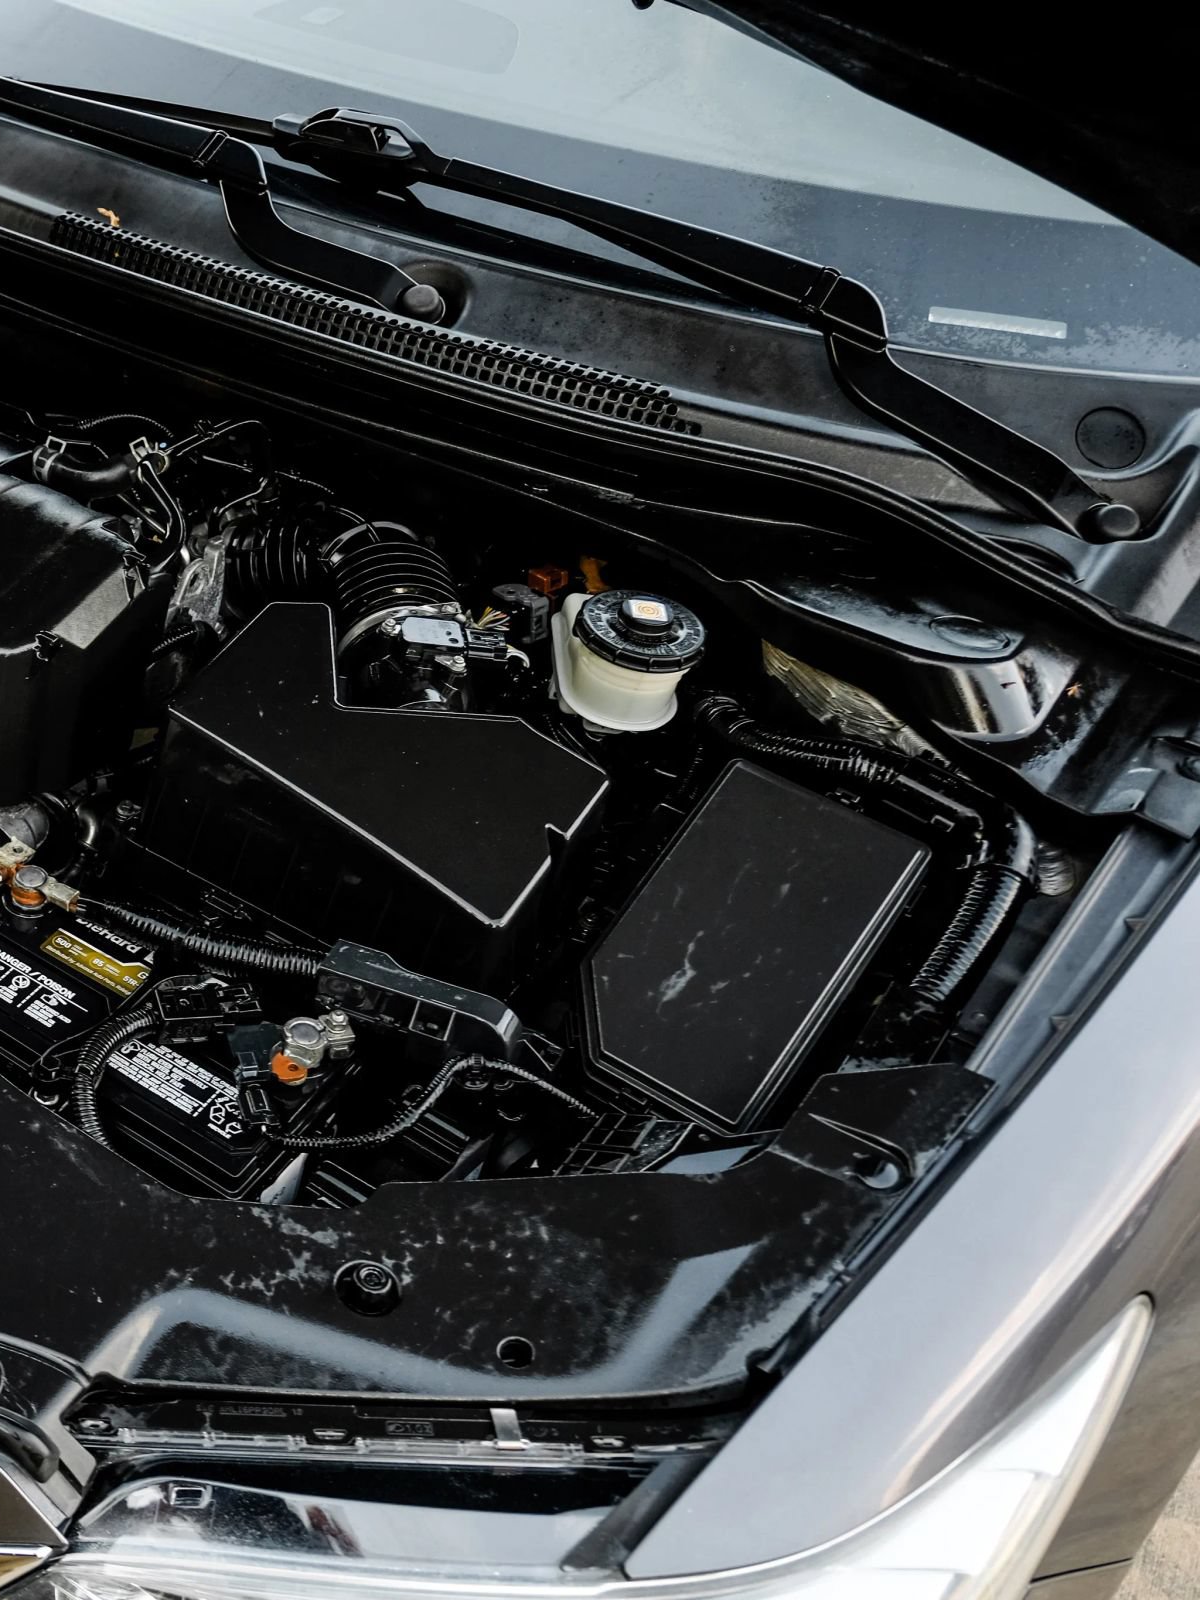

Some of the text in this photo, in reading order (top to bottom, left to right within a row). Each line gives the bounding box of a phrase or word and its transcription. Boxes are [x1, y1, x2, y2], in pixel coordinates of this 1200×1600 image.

[55, 937, 71, 948] 500
[92, 958, 104, 967] 85
[37, 974, 76, 1000] POISON
